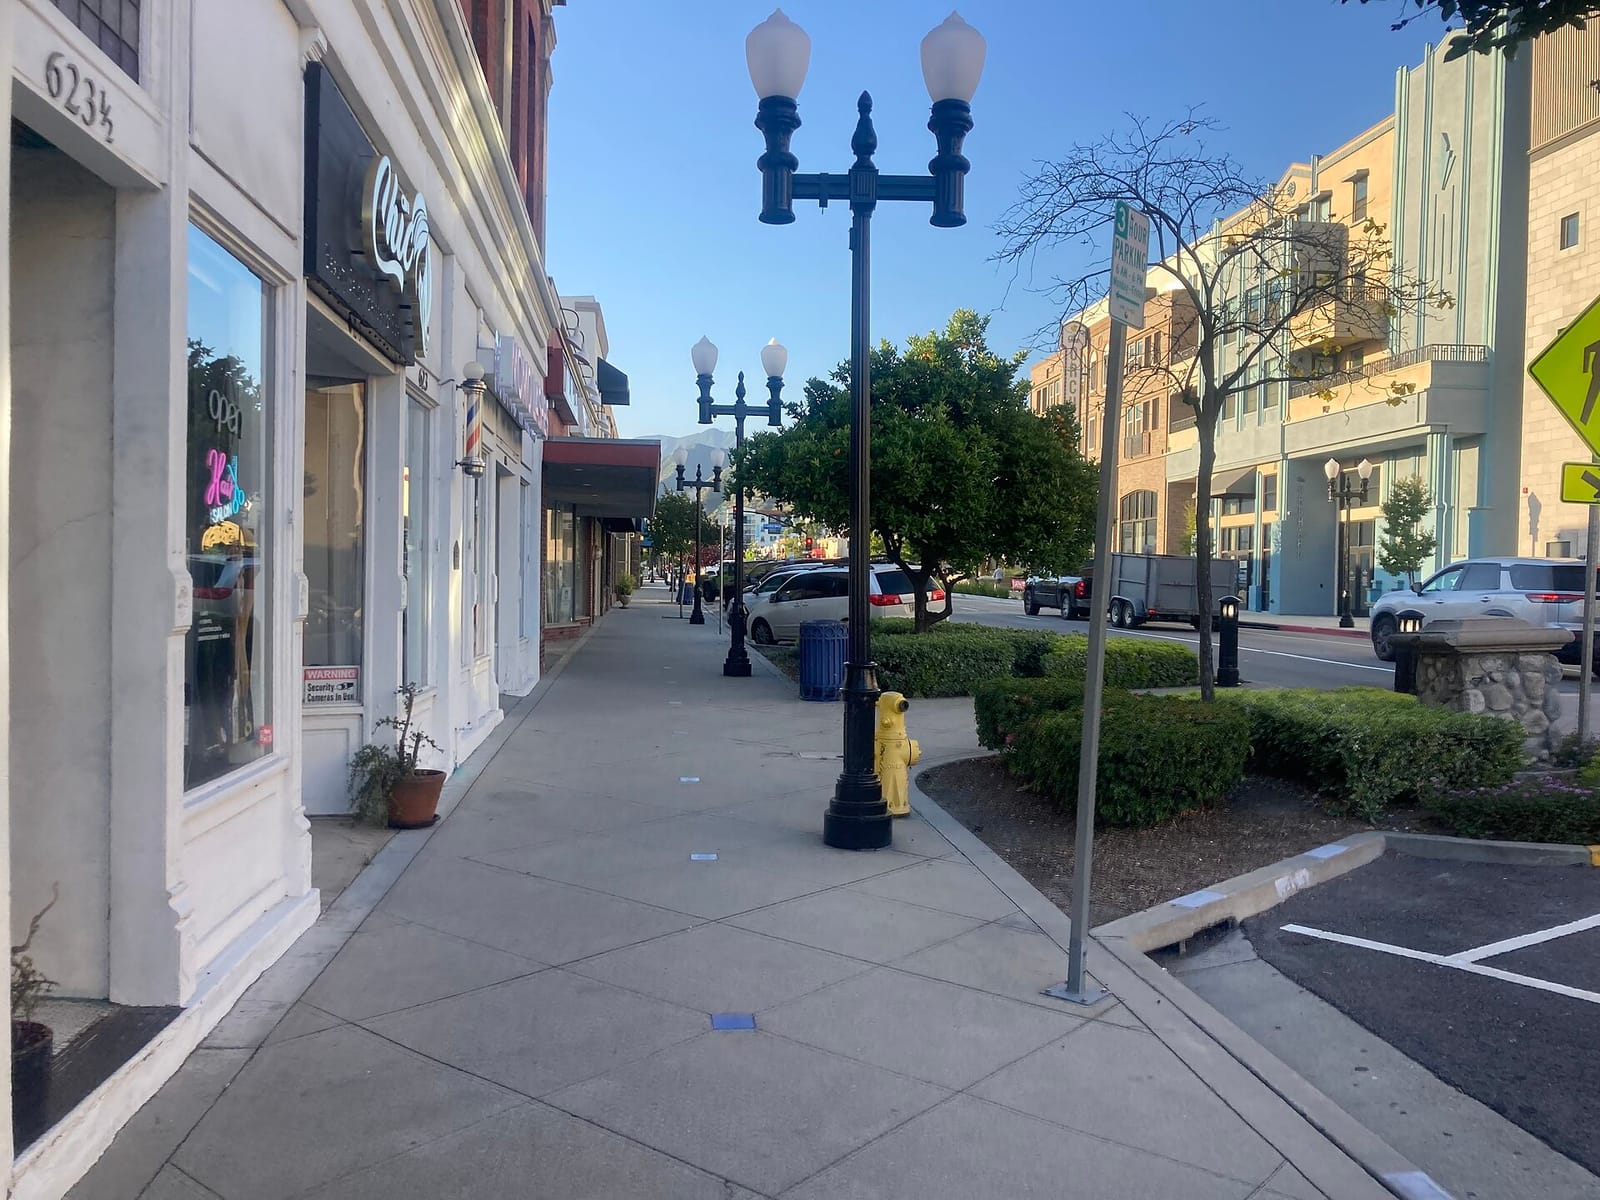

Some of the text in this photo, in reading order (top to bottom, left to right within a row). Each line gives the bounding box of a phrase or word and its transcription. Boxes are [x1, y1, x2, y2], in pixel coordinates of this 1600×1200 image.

[1117, 207, 1147, 244] 3 HOUR
[1115, 238, 1146, 273] PARKING
[209, 389, 243, 440] open
[306, 669, 356, 679] WARNING
[307, 682, 335, 692] Security
[307, 693, 334, 702] Cameras
